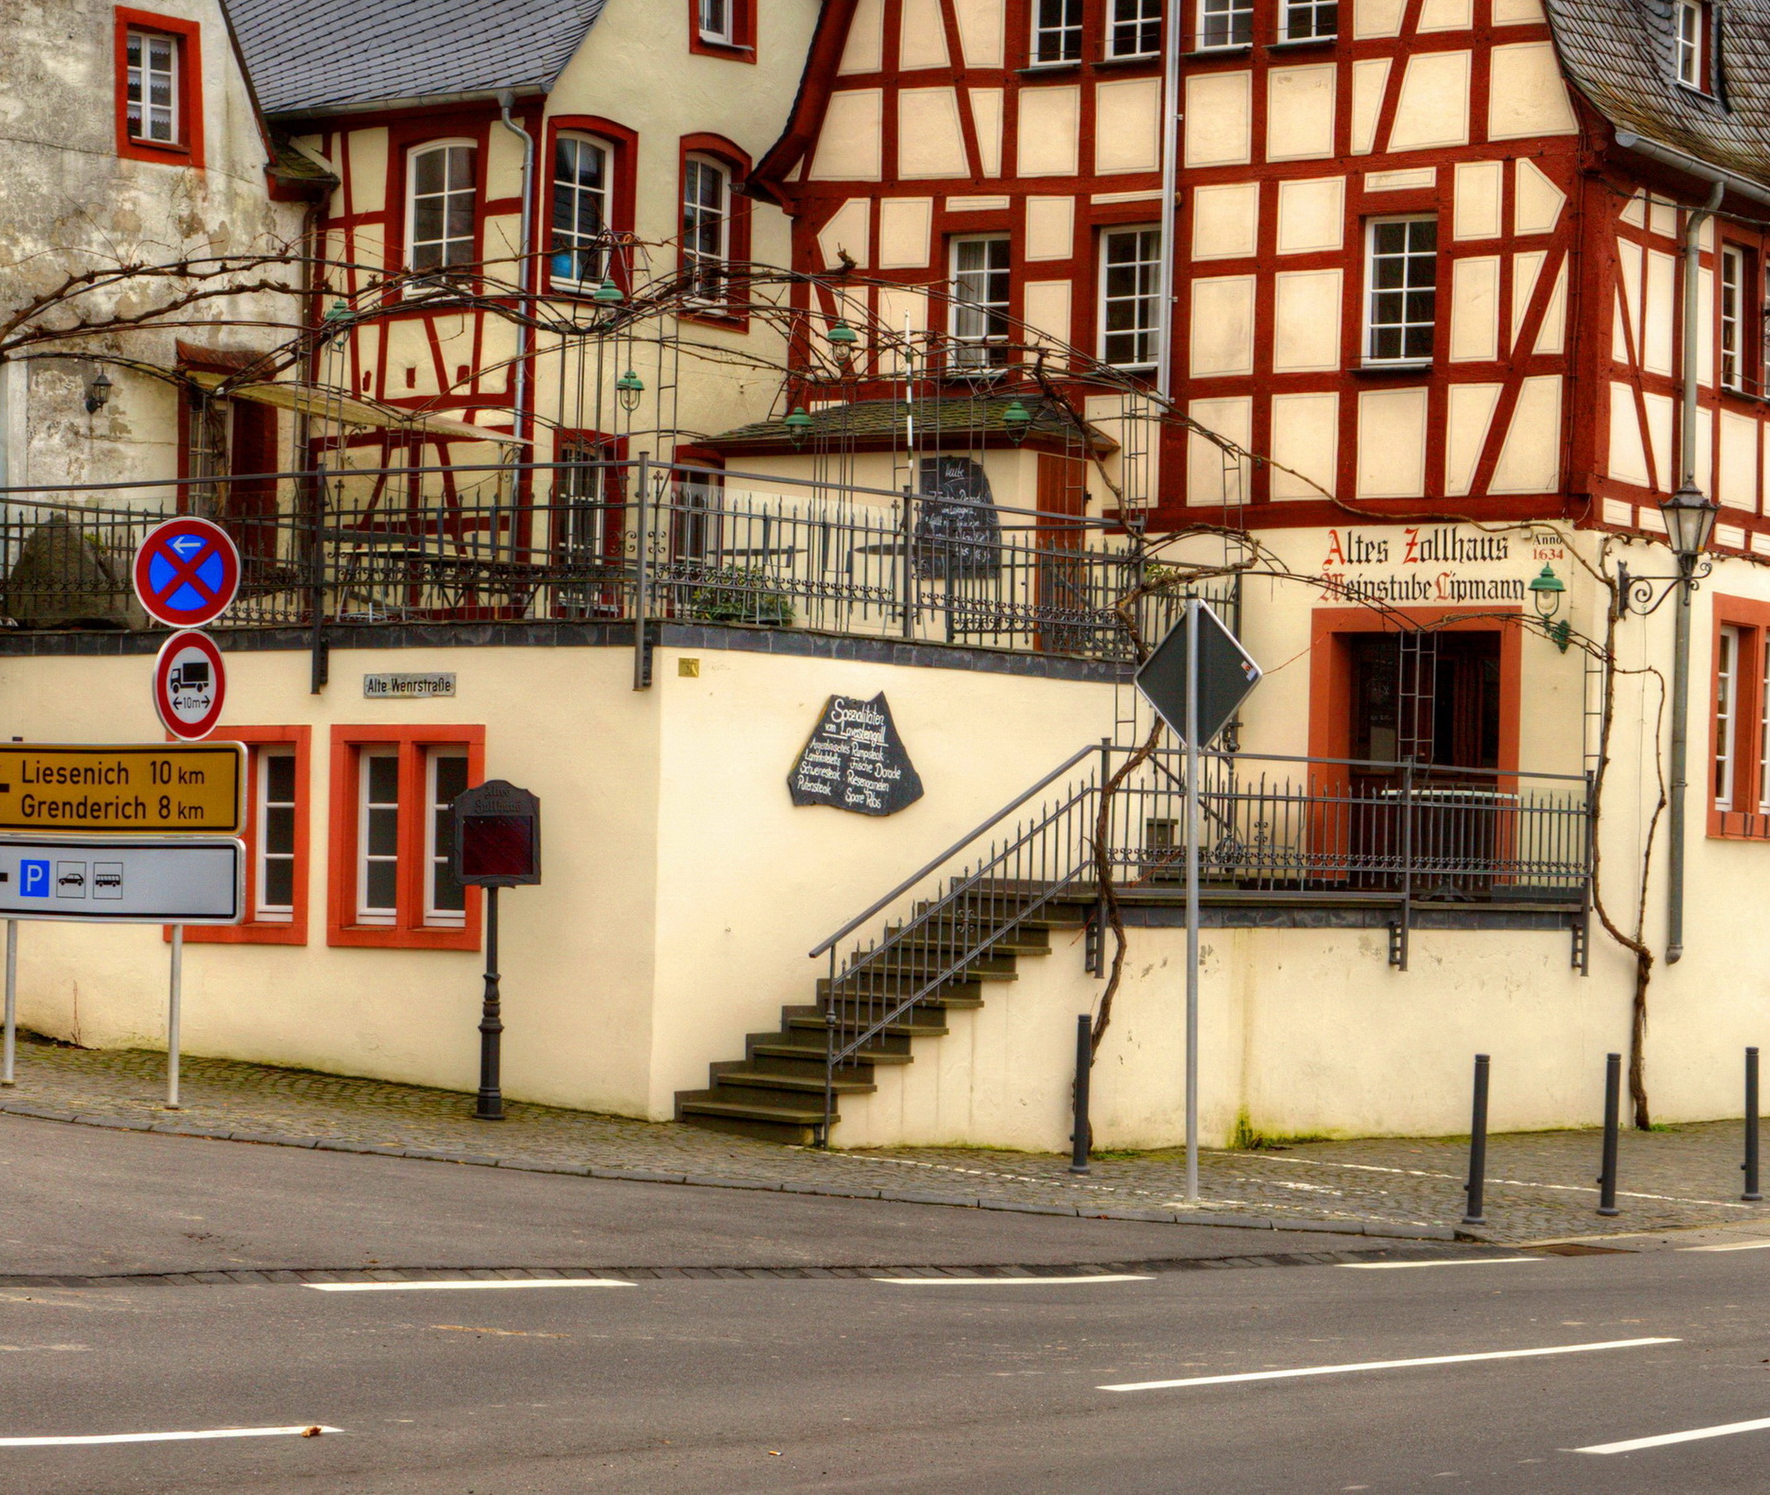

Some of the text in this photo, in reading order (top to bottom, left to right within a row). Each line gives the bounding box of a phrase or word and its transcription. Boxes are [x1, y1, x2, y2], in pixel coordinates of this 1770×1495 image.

[1322, 525, 1510, 567] Altes Zollhaus
[1533, 533, 1565, 547] Anno
[1532, 548, 1565, 561] 1634
[1319, 568, 1527, 605] Weinstube Lipmann
[367, 678, 388, 693] Alte
[851, 741, 884, 762] Rumpsteak
[22, 759, 205, 785] Liesenich 10 km
[850, 756, 901, 780] Frische Dorade
[21, 794, 205, 820] Grenderich 8 km
[27, 864, 43, 892] P
